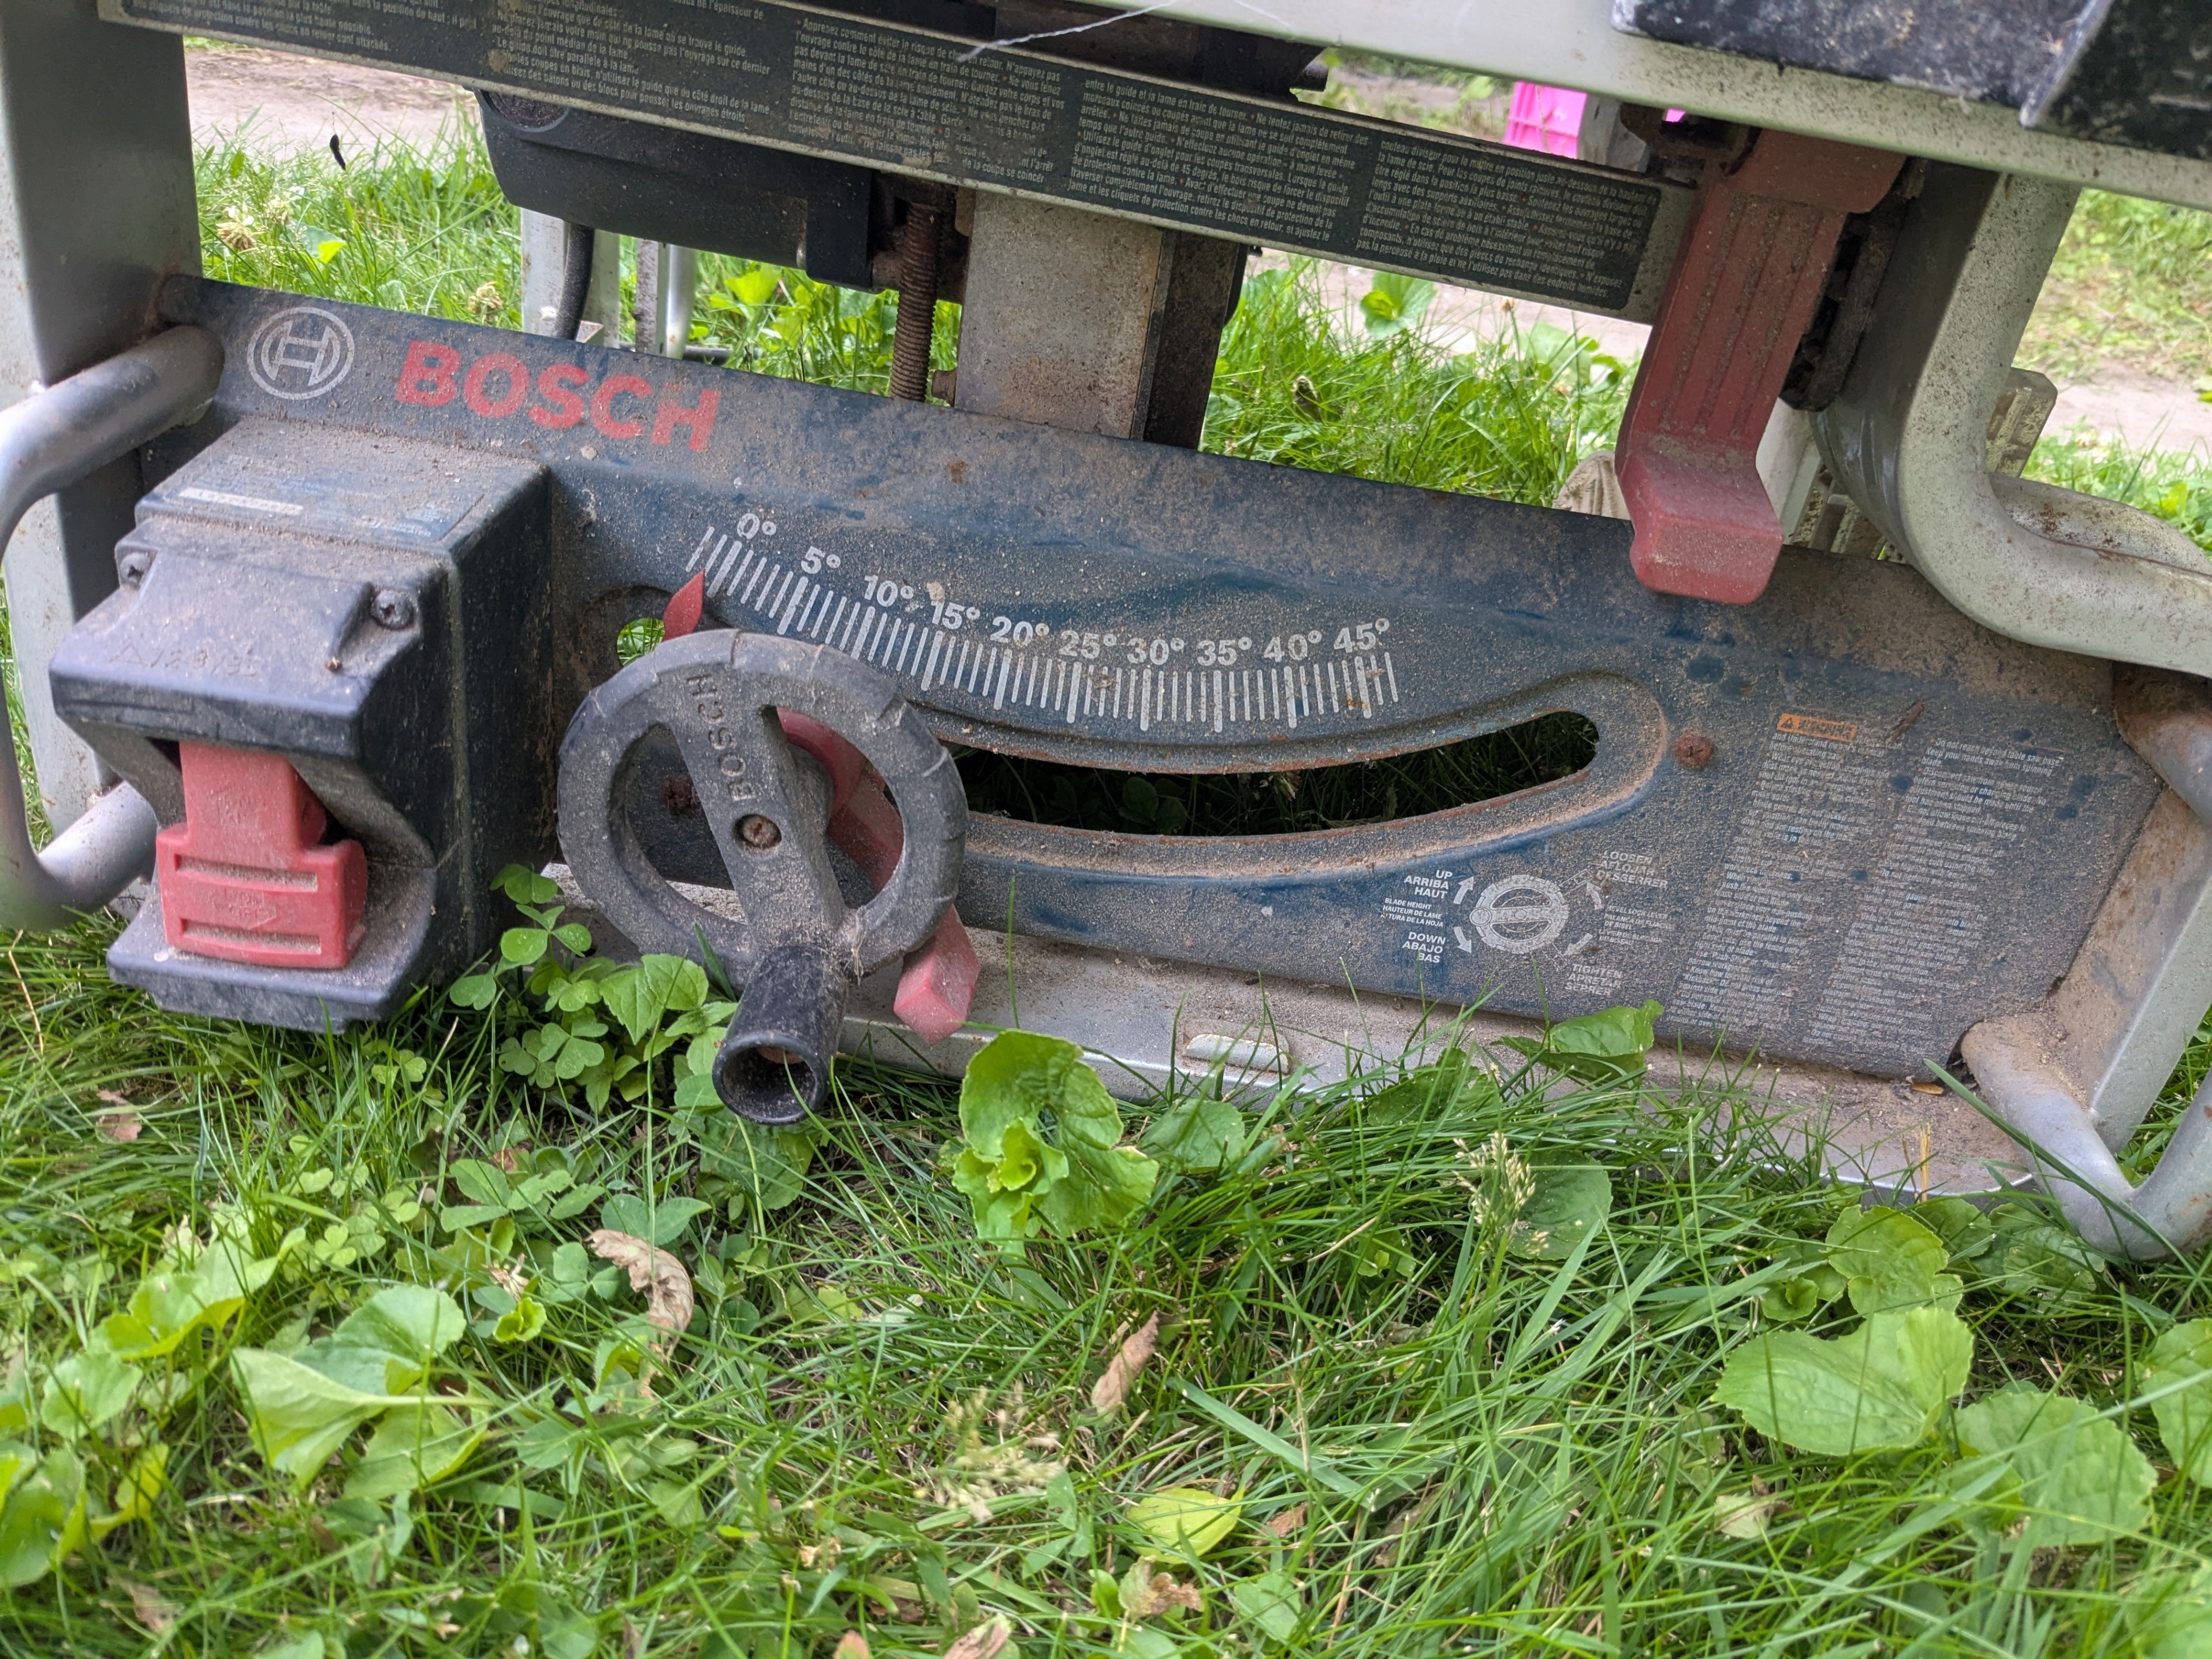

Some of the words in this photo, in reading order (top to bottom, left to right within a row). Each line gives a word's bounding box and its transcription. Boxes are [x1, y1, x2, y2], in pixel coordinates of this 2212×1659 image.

[754, 9, 763, 20] de
[535, 31, 554, 45] point
[587, 42, 597, 52] de
[677, 35, 686, 44] se
[795, 31, 831, 49] l'ouvrage
[833, 38, 857, 52] contre
[841, 27, 875, 43] comment
[663, 46, 677, 58] pas
[717, 57, 729, 66] sur
[731, 59, 739, 68] ce
[742, 60, 770, 75] dernier
[794, 46, 809, 57] pas
[837, 53, 845, 63] la
[847, 55, 866, 68] lame
[869, 59, 877, 70] de
[794, 57, 817, 70] mains
[819, 62, 835, 75] d'un
[940, 61, 958, 73] train
[959, 65, 969, 76] de
[1047, 72, 1060, 83] pas
[832, 92, 841, 102] de
[999, 87, 1018, 99] votre
[1019, 93, 1040, 106] corps
[1042, 96, 1049, 106] et
[1051, 100, 1064, 109] vos
[1085, 78, 1104, 90] entre
[1107, 83, 1114, 92] le
[1116, 84, 1137, 99] guide
[1139, 89, 1146, 99] et
[1157, 93, 1176, 105] lame
[730, 96, 739, 107] de
[750, 101, 769, 114] lame
[1078, 117, 1101, 131] temps
[1104, 124, 1116, 134] que
[1120, 125, 1142, 138] l'autre
[1295, 135, 1347, 155] complètement
[1073, 154, 1082, 165] de
[1083, 157, 1120, 174] protection
[1123, 165, 1145, 178] contre
[1148, 170, 1155, 180] la
[1107, 148, 1118, 159] est
[1141, 155, 1168, 169] au-delà
[1170, 162, 1179, 172] de
[1181, 164, 1190, 174] 45
[1175, 151, 1192, 163] pour
[1207, 158, 1232, 172] coupes
[1378, 152, 1385, 161] la
[1387, 154, 1405, 166] lame
[1407, 158, 1416, 168] de
[982, 164, 1004, 176] coupe
[1016, 170, 1044, 183] coincer
[1070, 167, 1103, 182] traverser
[1105, 174, 1157, 195] complètement
[1222, 172, 1228, 182] le
[1231, 174, 1246, 185] bois
[1247, 177, 1270, 193] risque
[1272, 183, 1281, 192] de
[1283, 185, 1304, 198] forcer
[1306, 190, 1313, 199] le
[1315, 192, 1349, 209] dispositif
[1372, 177, 1391, 191] longs
[1394, 183, 1410, 193] avec
[1412, 185, 1425, 196] des
[1426, 188, 1458, 204] supports
[1391, 168, 1410, 182] réglé
[1412, 172, 1429, 184] dans
[1479, 185, 1494, 199] plus
[1068, 179, 1087, 191] lame
[1089, 183, 1097, 194] et
[1098, 185, 1109, 196] les
[1111, 188, 1139, 204] cliquets
[1141, 194, 1150, 204] de
[1152, 196, 1189, 214] protection
[1190, 204, 1213, 217] contre
[1223, 198, 1229, 208] le
[1266, 207, 1275, 217] de
[1276, 210, 1313, 227] protection
[1314, 218, 1323, 228] de
[1325, 220, 1332, 229] la
[1286, 200, 1294, 209] ne
[1297, 201, 1321, 214] devant
[1323, 208, 1335, 219] pas
[1215, 210, 1226, 220] les
[1227, 212, 1247, 225] chocs
[1250, 218, 1258, 227] en
[1295, 226, 1320, 241] ajustez
[1322, 232, 1329, 241] le
[1372, 241, 1379, 250] la
[1455, 247, 1468, 256] des
[396, 340, 721, 451] BOSCH
[736, 513, 777, 540] 0°
[801, 546, 840, 575] 5°
[864, 575, 914, 607] 10°
[930, 600, 980, 630] 15°
[990, 616, 1049, 646] 20°
[1059, 629, 1117, 659] 25°
[1127, 638, 1185, 665] 30°
[1197, 637, 1252, 666] 35°
[1263, 630, 1322, 662] 40°
[1333, 618, 1389, 653] 45°
[686, 674, 757, 801] BOSCH
[2021, 763, 2052, 777] spinning
[1604, 850, 1652, 864] LOOSEN
[1403, 875, 1448, 890] ARRIBA
[1436, 870, 1453, 879] UP
[1414, 887, 1447, 898] HAUT
[1383, 905, 1413, 914] HAUTEUR
[1385, 898, 1406, 906] BLADE
[1407, 901, 1432, 910] HEIGHT
[1402, 941, 1443, 953] ABAJO
[1408, 932, 1446, 944] DOWN
[1417, 953, 1440, 963] BAS
